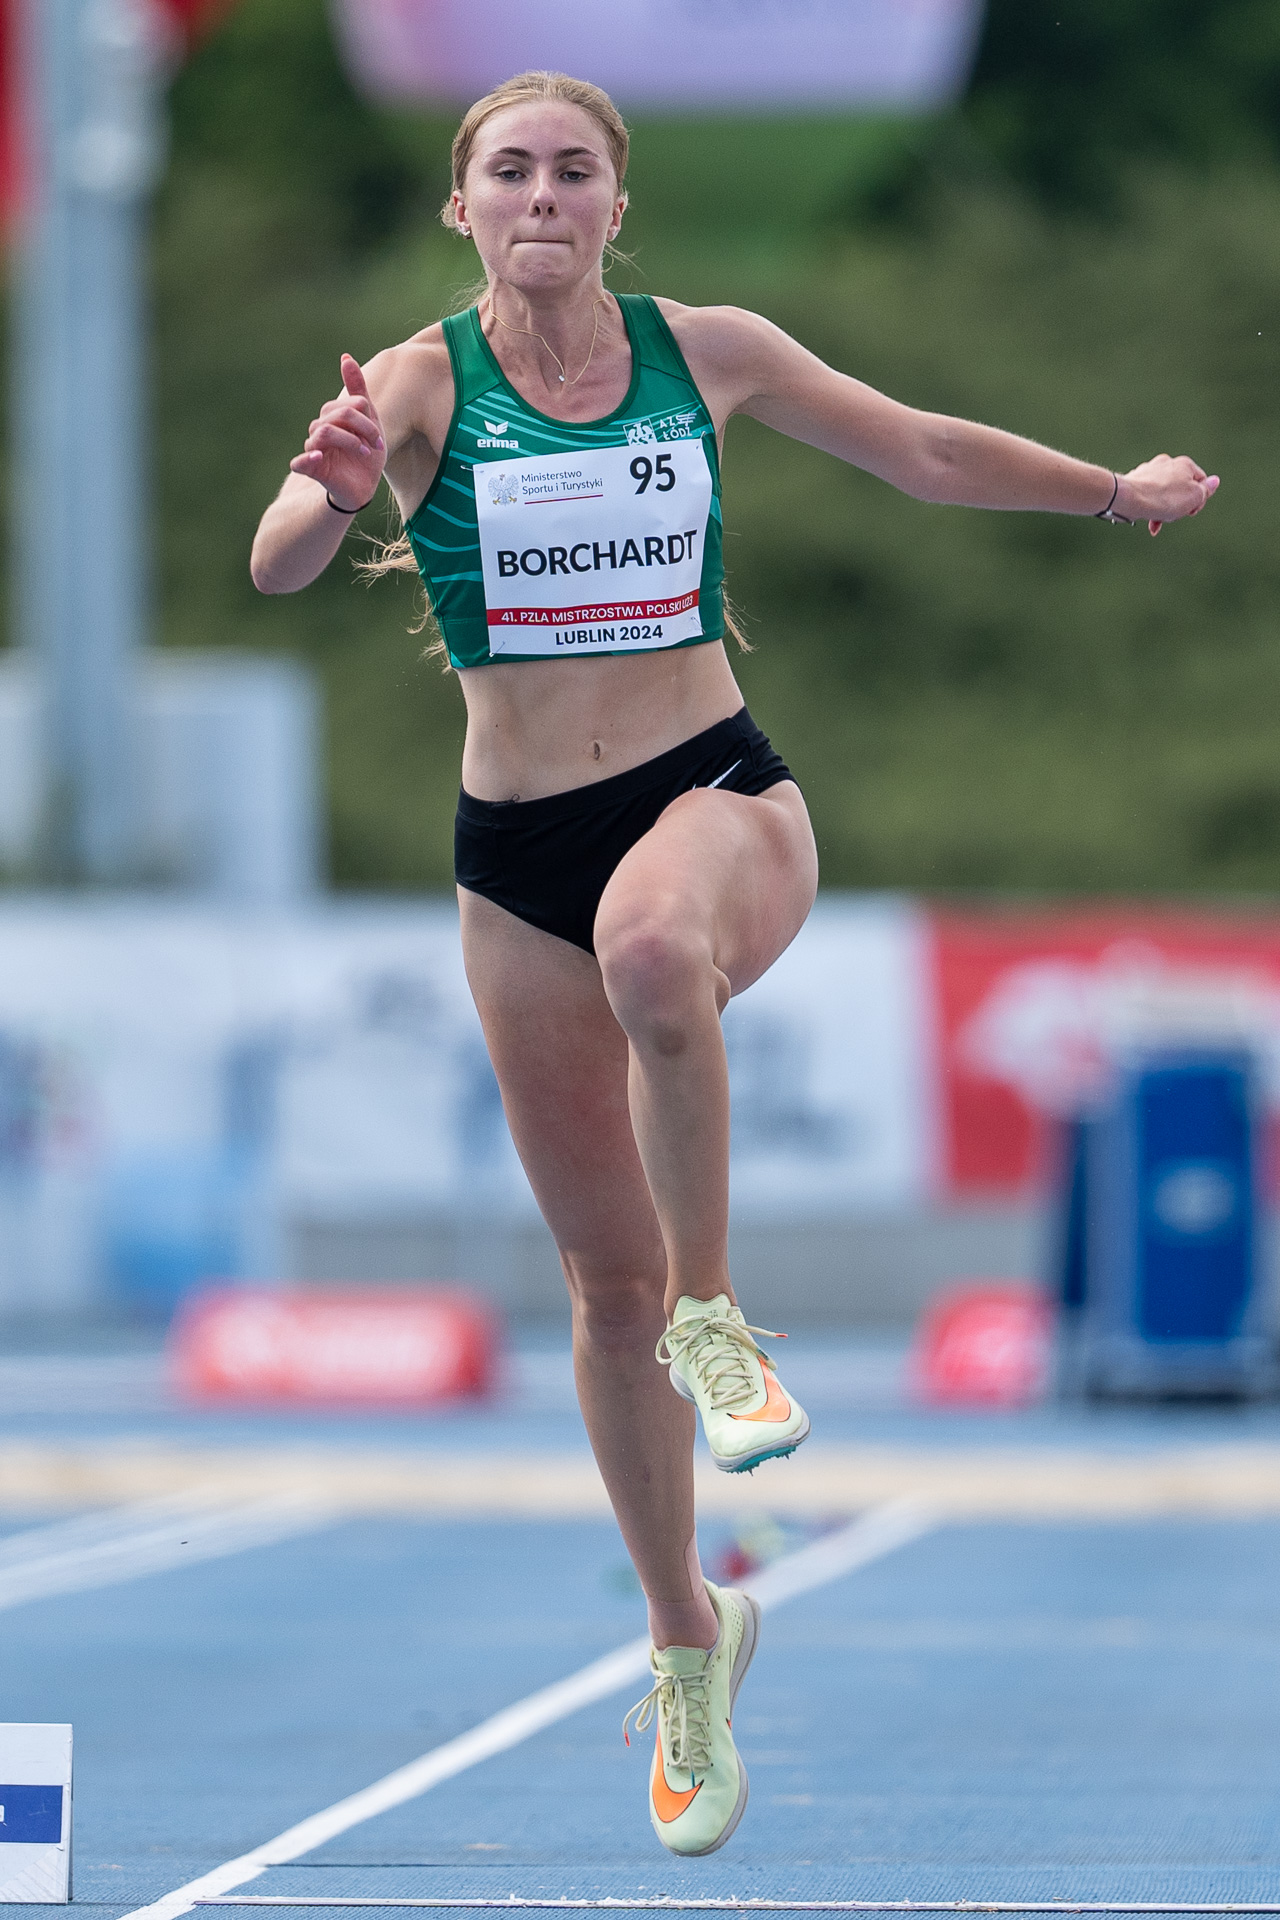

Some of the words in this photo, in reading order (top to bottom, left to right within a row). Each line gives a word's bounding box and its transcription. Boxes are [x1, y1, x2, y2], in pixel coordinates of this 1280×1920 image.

[477, 437, 519, 449] erima
[521, 470, 582, 483] Ministerstwo
[629, 453, 676, 495] 95
[522, 483, 554, 496] Sportu
[556, 482, 559, 492] i
[561, 478, 603, 492] Turystyki
[497, 529, 698, 577] BORCHARDT
[501, 611, 518, 623] 41.
[520, 611, 549, 623] PZLA
[552, 607, 643, 623] MISTRZOSTWA
[646, 600, 682, 616] POLSKI
[555, 628, 616, 646] LUBLIN
[619, 624, 664, 642] 2024
